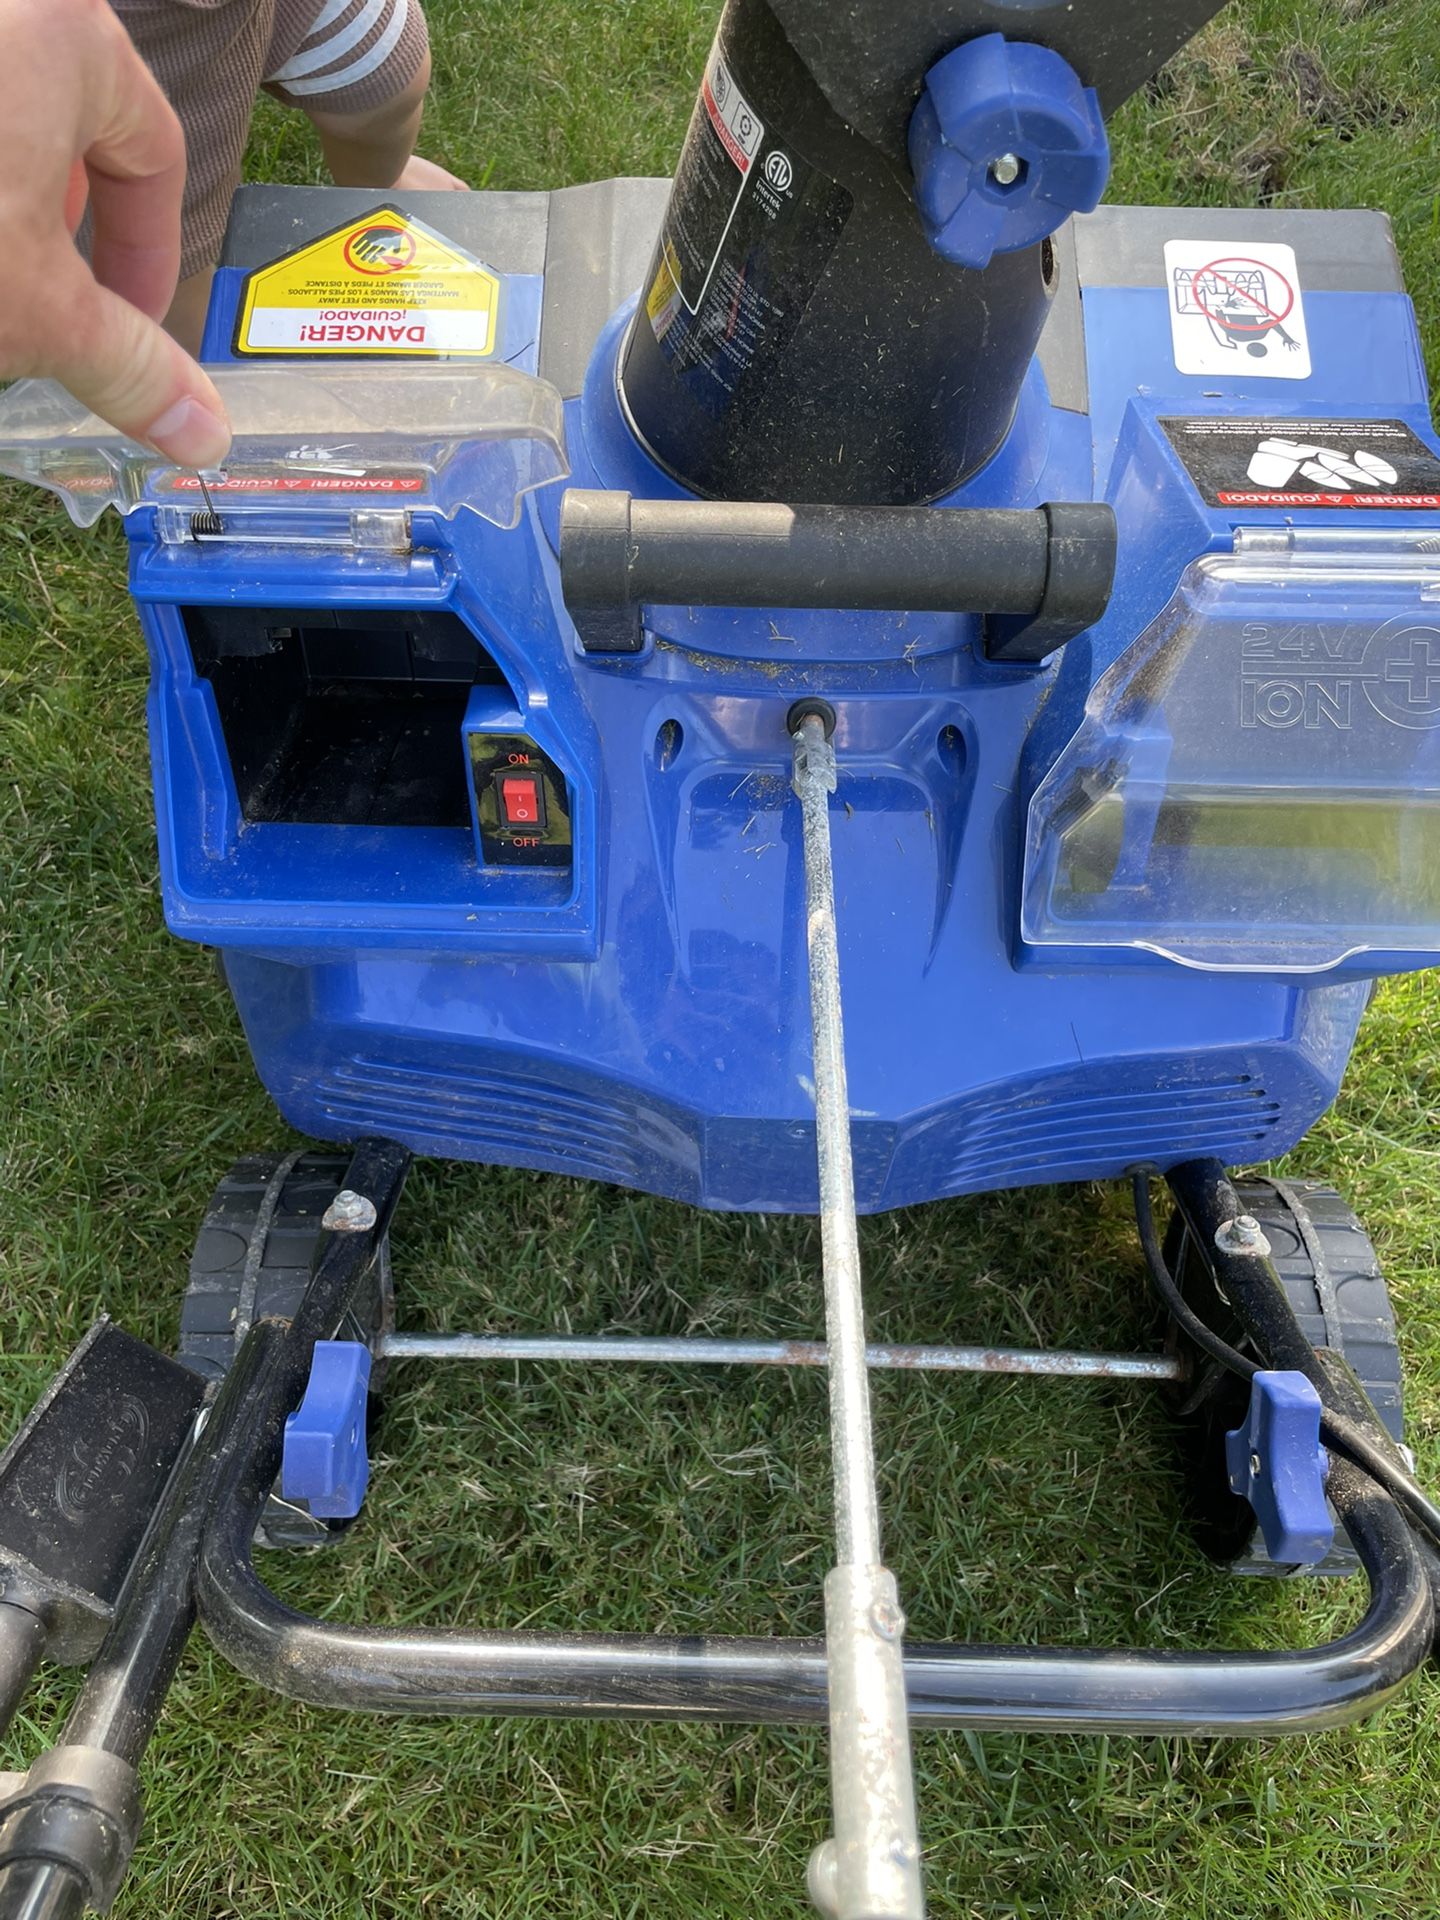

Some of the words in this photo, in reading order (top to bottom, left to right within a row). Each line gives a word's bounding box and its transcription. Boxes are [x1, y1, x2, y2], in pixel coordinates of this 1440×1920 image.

[756, 180, 781, 210] Intertek
[319, 309, 407, 321] ¡CUIDADO!
[300, 324, 426, 342] DANGER!
[310, 480, 393, 488] DANGER!
[1226, 494, 1320, 503] ¡CUIDADO!
[1356, 496, 1438, 504] DANGER!
[1241, 622, 1354, 658] 24V
[1240, 679, 1352, 730] ION
[508, 753, 529, 764] ON
[513, 837, 540, 847] OFF
